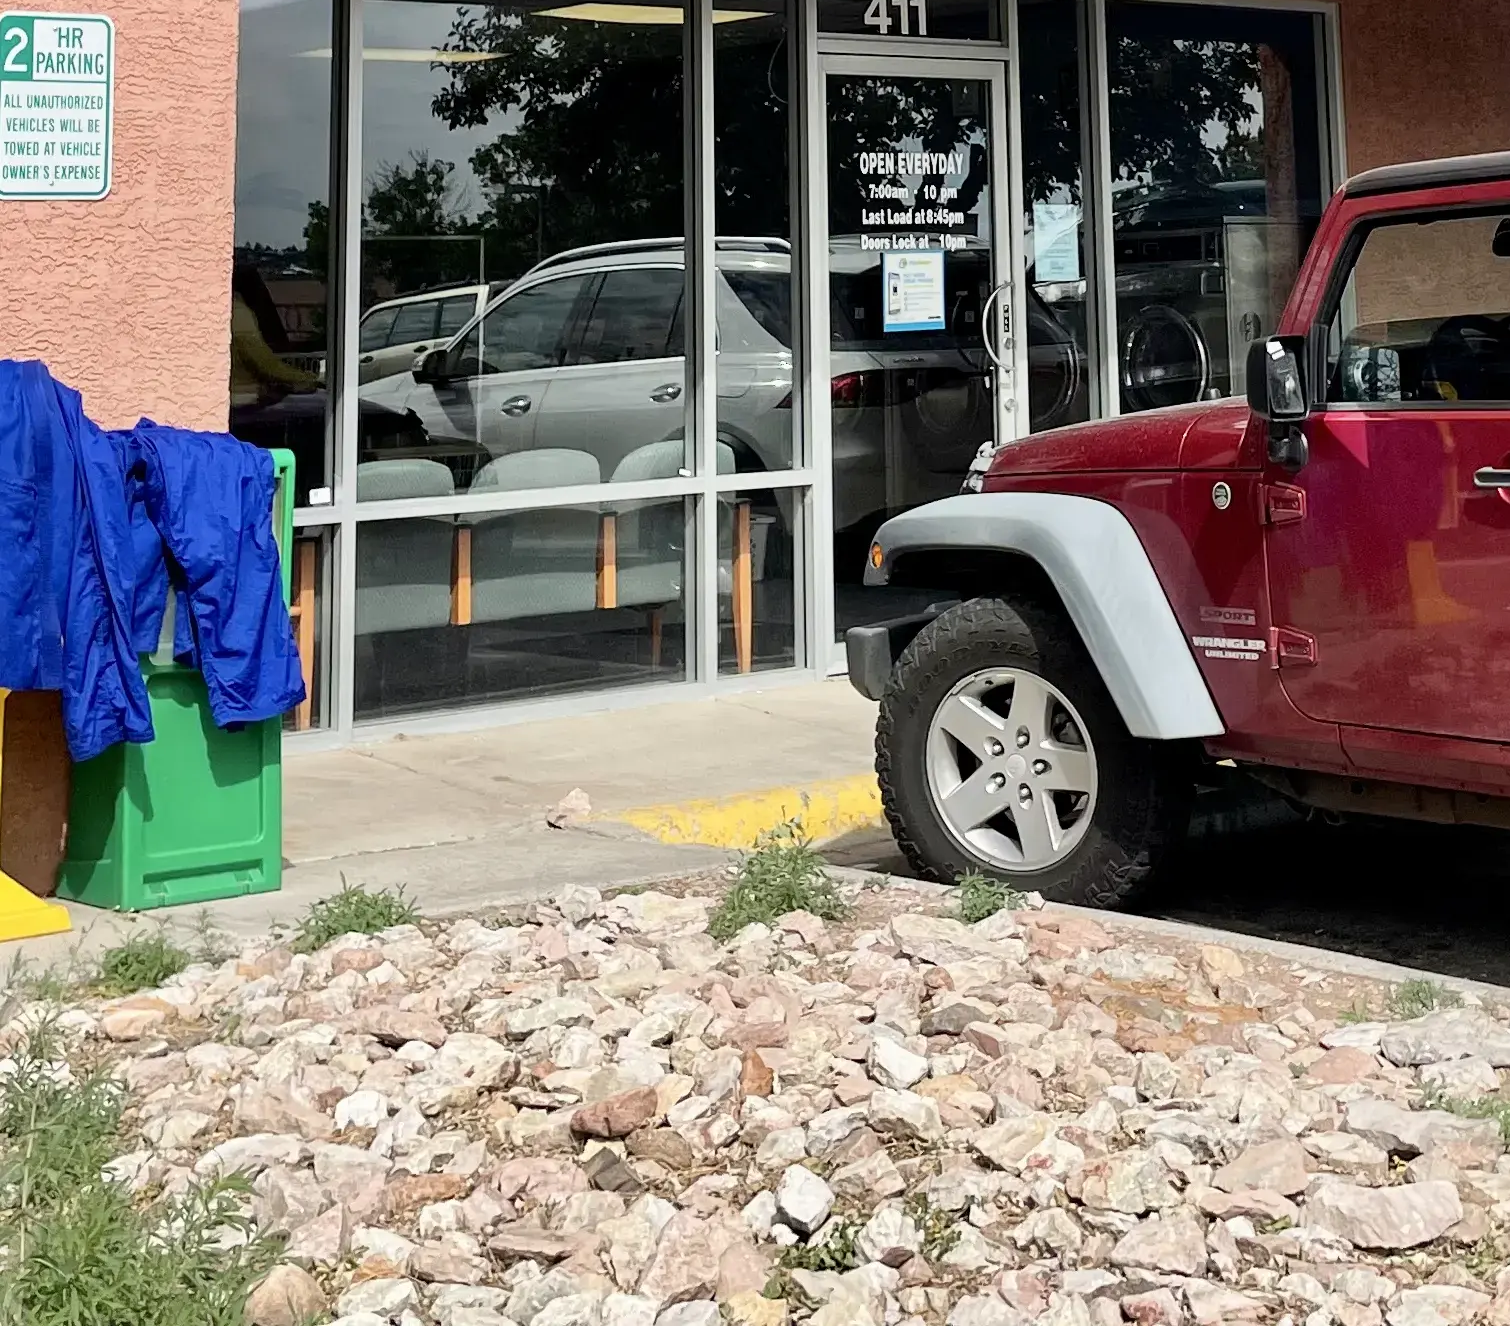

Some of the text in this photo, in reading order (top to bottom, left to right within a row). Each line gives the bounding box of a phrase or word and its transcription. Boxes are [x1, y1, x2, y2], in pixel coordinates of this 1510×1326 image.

[57, 27, 84, 49] HR
[3, 27, 29, 72] 2
[36, 52, 104, 75] PARKING
[4, 94, 104, 110] ALL UNAUTHORIZED
[6, 117, 100, 133] VEHICLES WILL BE
[4, 141, 101, 156] TOWED AT VEHICLE
[860, 152, 964, 175] OPEN EVERYDAY
[2, 165, 100, 180] OWNER'S EXPENSE
[869, 184, 909, 199] 7:00am
[923, 185, 937, 200] 10
[940, 187, 958, 204] pm
[862, 208, 964, 228] Last Load at 8:45pm
[861, 234, 967, 251] Doors Lock at 10pm
[1203, 610, 1253, 622] SPORT
[1192, 636, 1266, 651] WRANGLER
